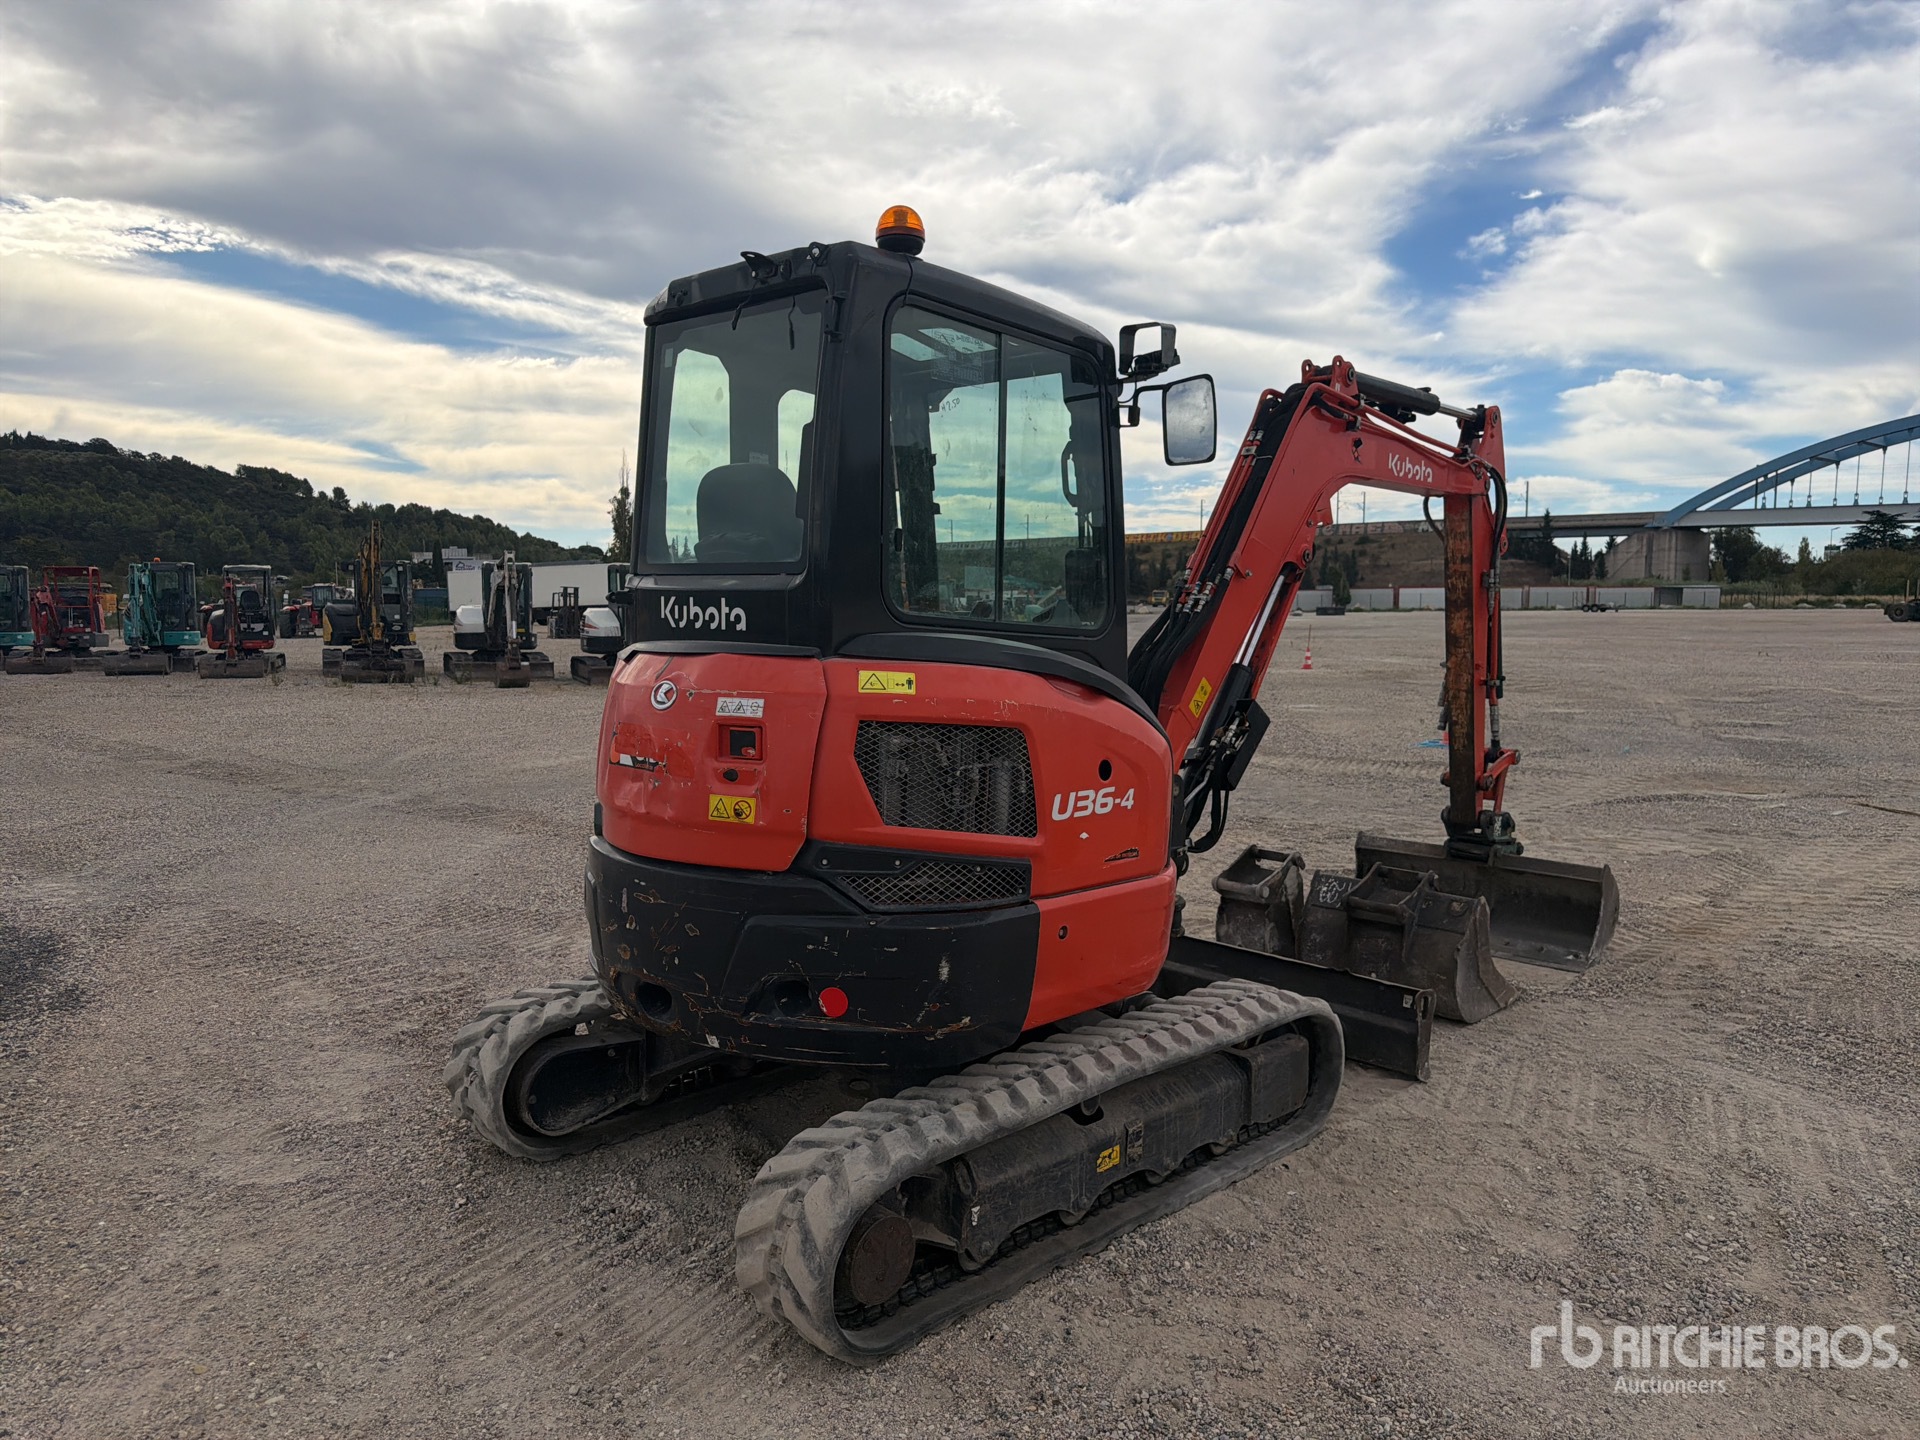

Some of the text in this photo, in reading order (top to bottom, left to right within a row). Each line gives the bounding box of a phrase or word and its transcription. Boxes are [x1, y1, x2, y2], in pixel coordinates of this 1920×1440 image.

[1389, 453, 1433, 483] Kubota
[660, 595, 747, 631] Kubota
[1052, 786, 1135, 821] U36-4
